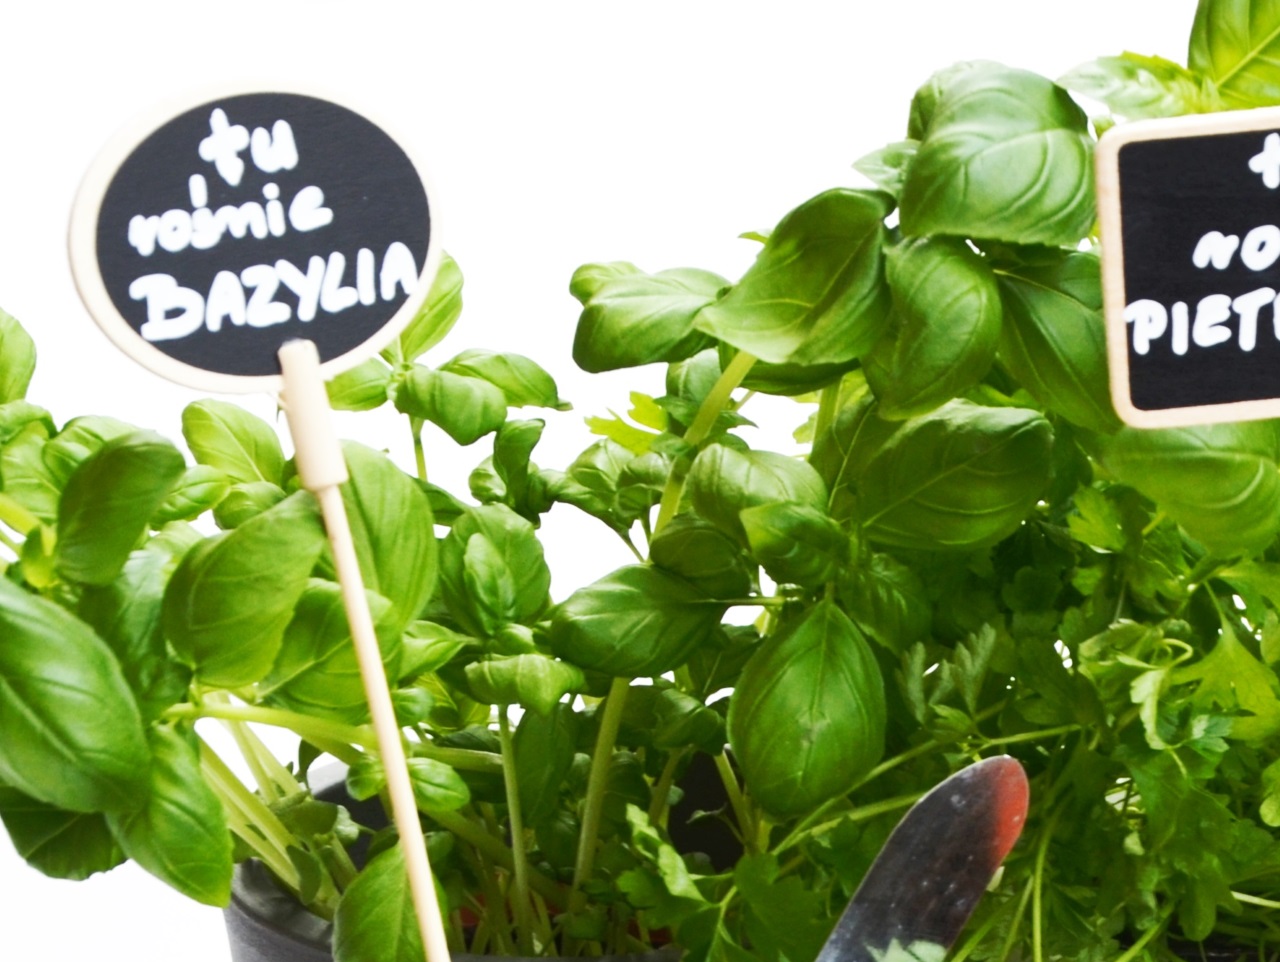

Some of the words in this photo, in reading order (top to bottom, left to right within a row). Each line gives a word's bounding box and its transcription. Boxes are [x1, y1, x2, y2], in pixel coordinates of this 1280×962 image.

[199, 108, 298, 186] tu
[128, 174, 334, 256] rośnie
[129, 241, 418, 341] BAZYLIA
